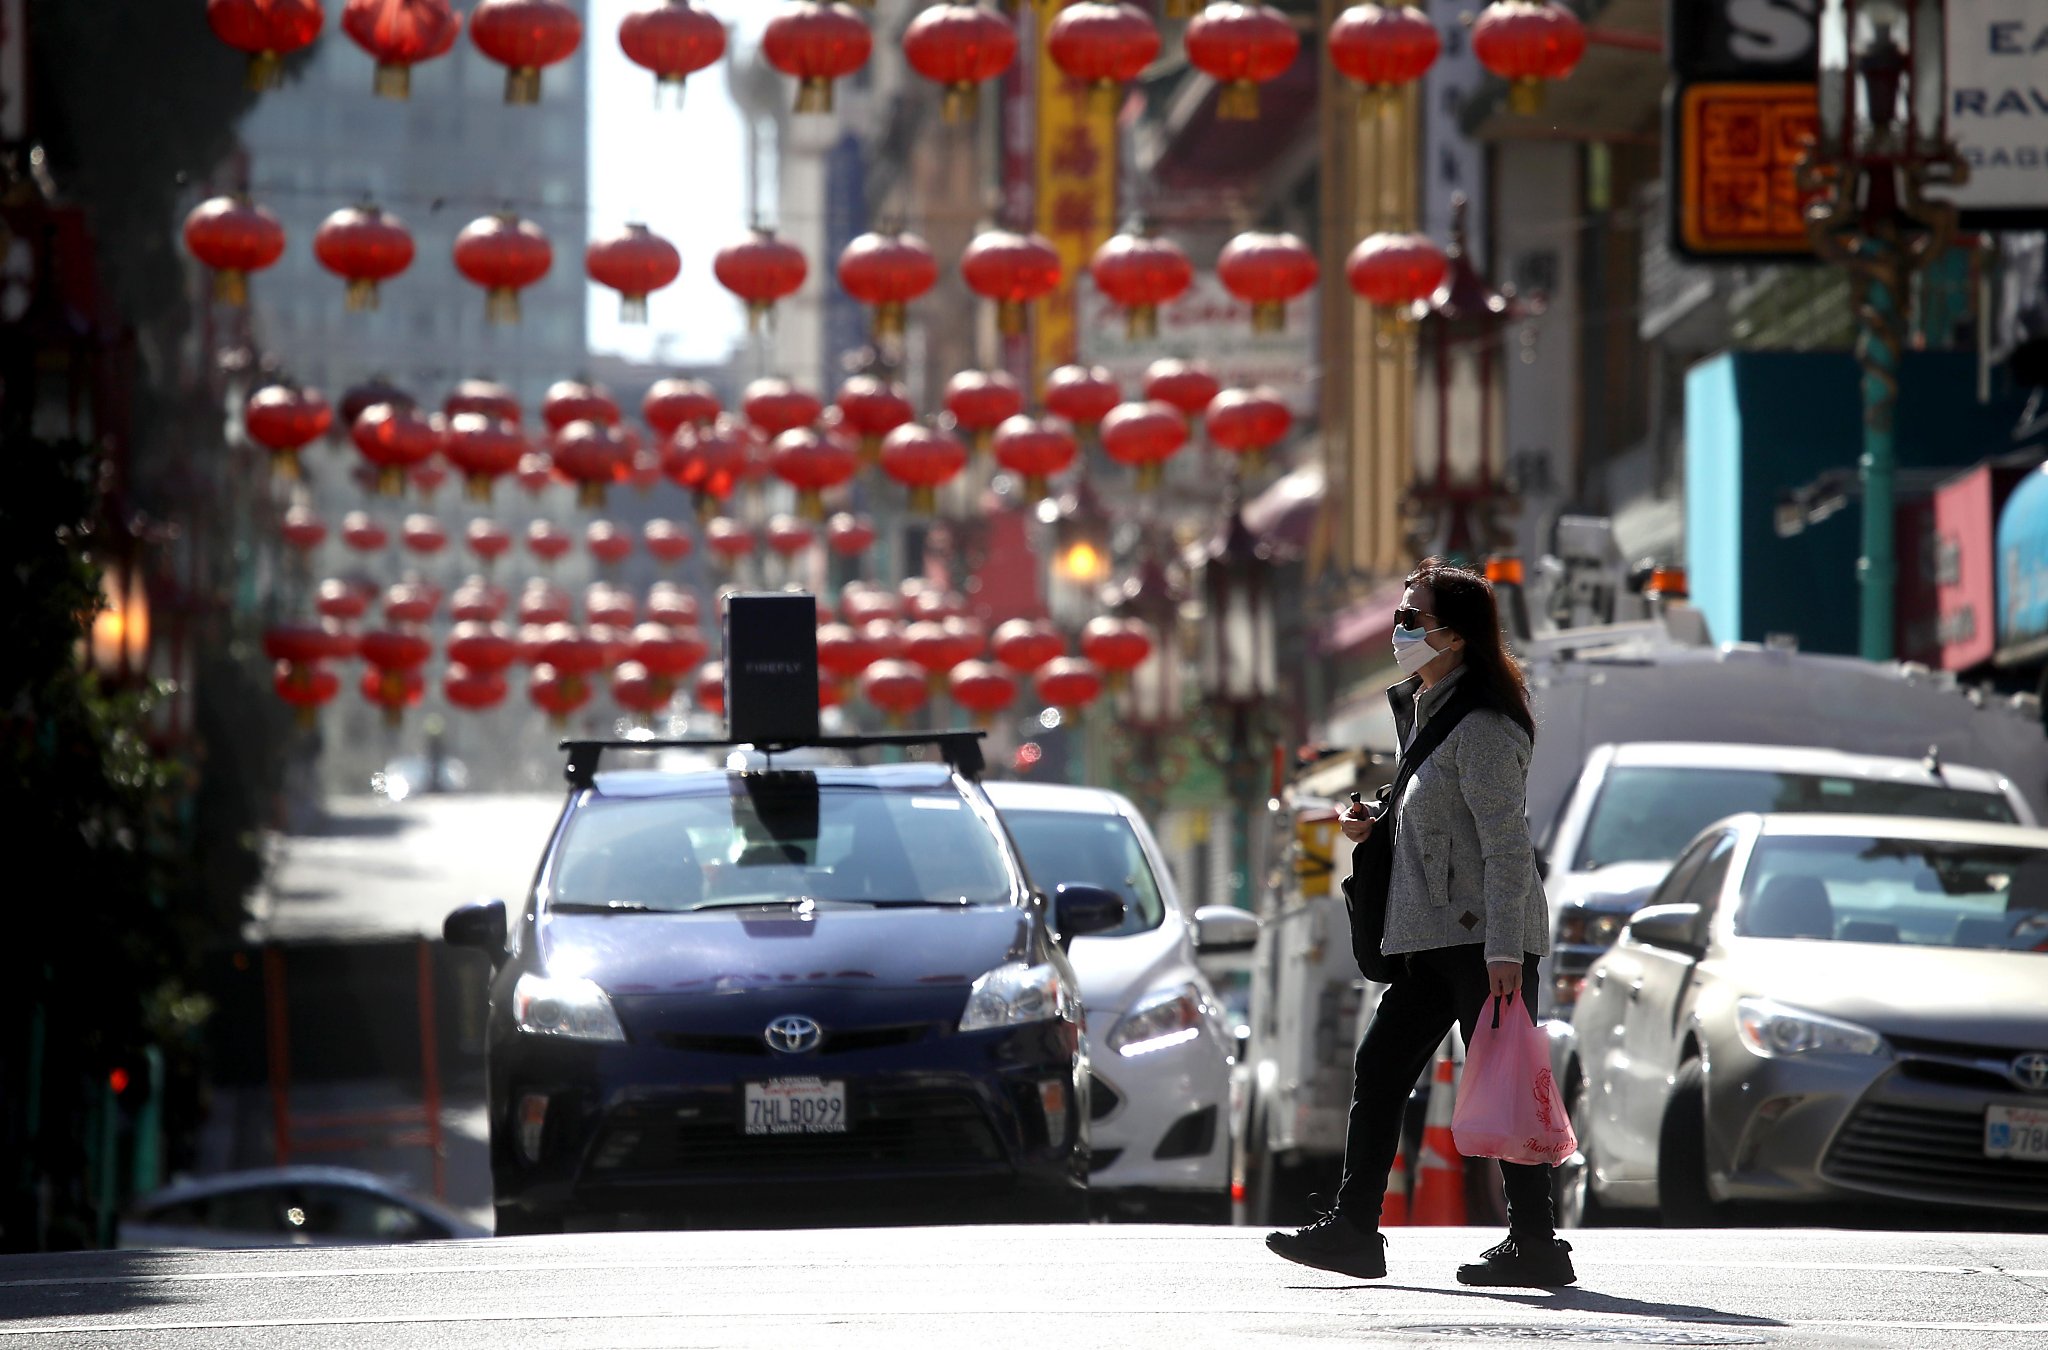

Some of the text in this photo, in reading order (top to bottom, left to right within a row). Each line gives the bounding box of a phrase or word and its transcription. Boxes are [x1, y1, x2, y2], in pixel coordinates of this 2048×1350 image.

[745, 663, 802, 674] FIREFLY
[750, 1099, 841, 1125] 7HLB099
[770, 1125, 802, 1133] SMITH
[806, 1124, 846, 1132] TOYOTA
